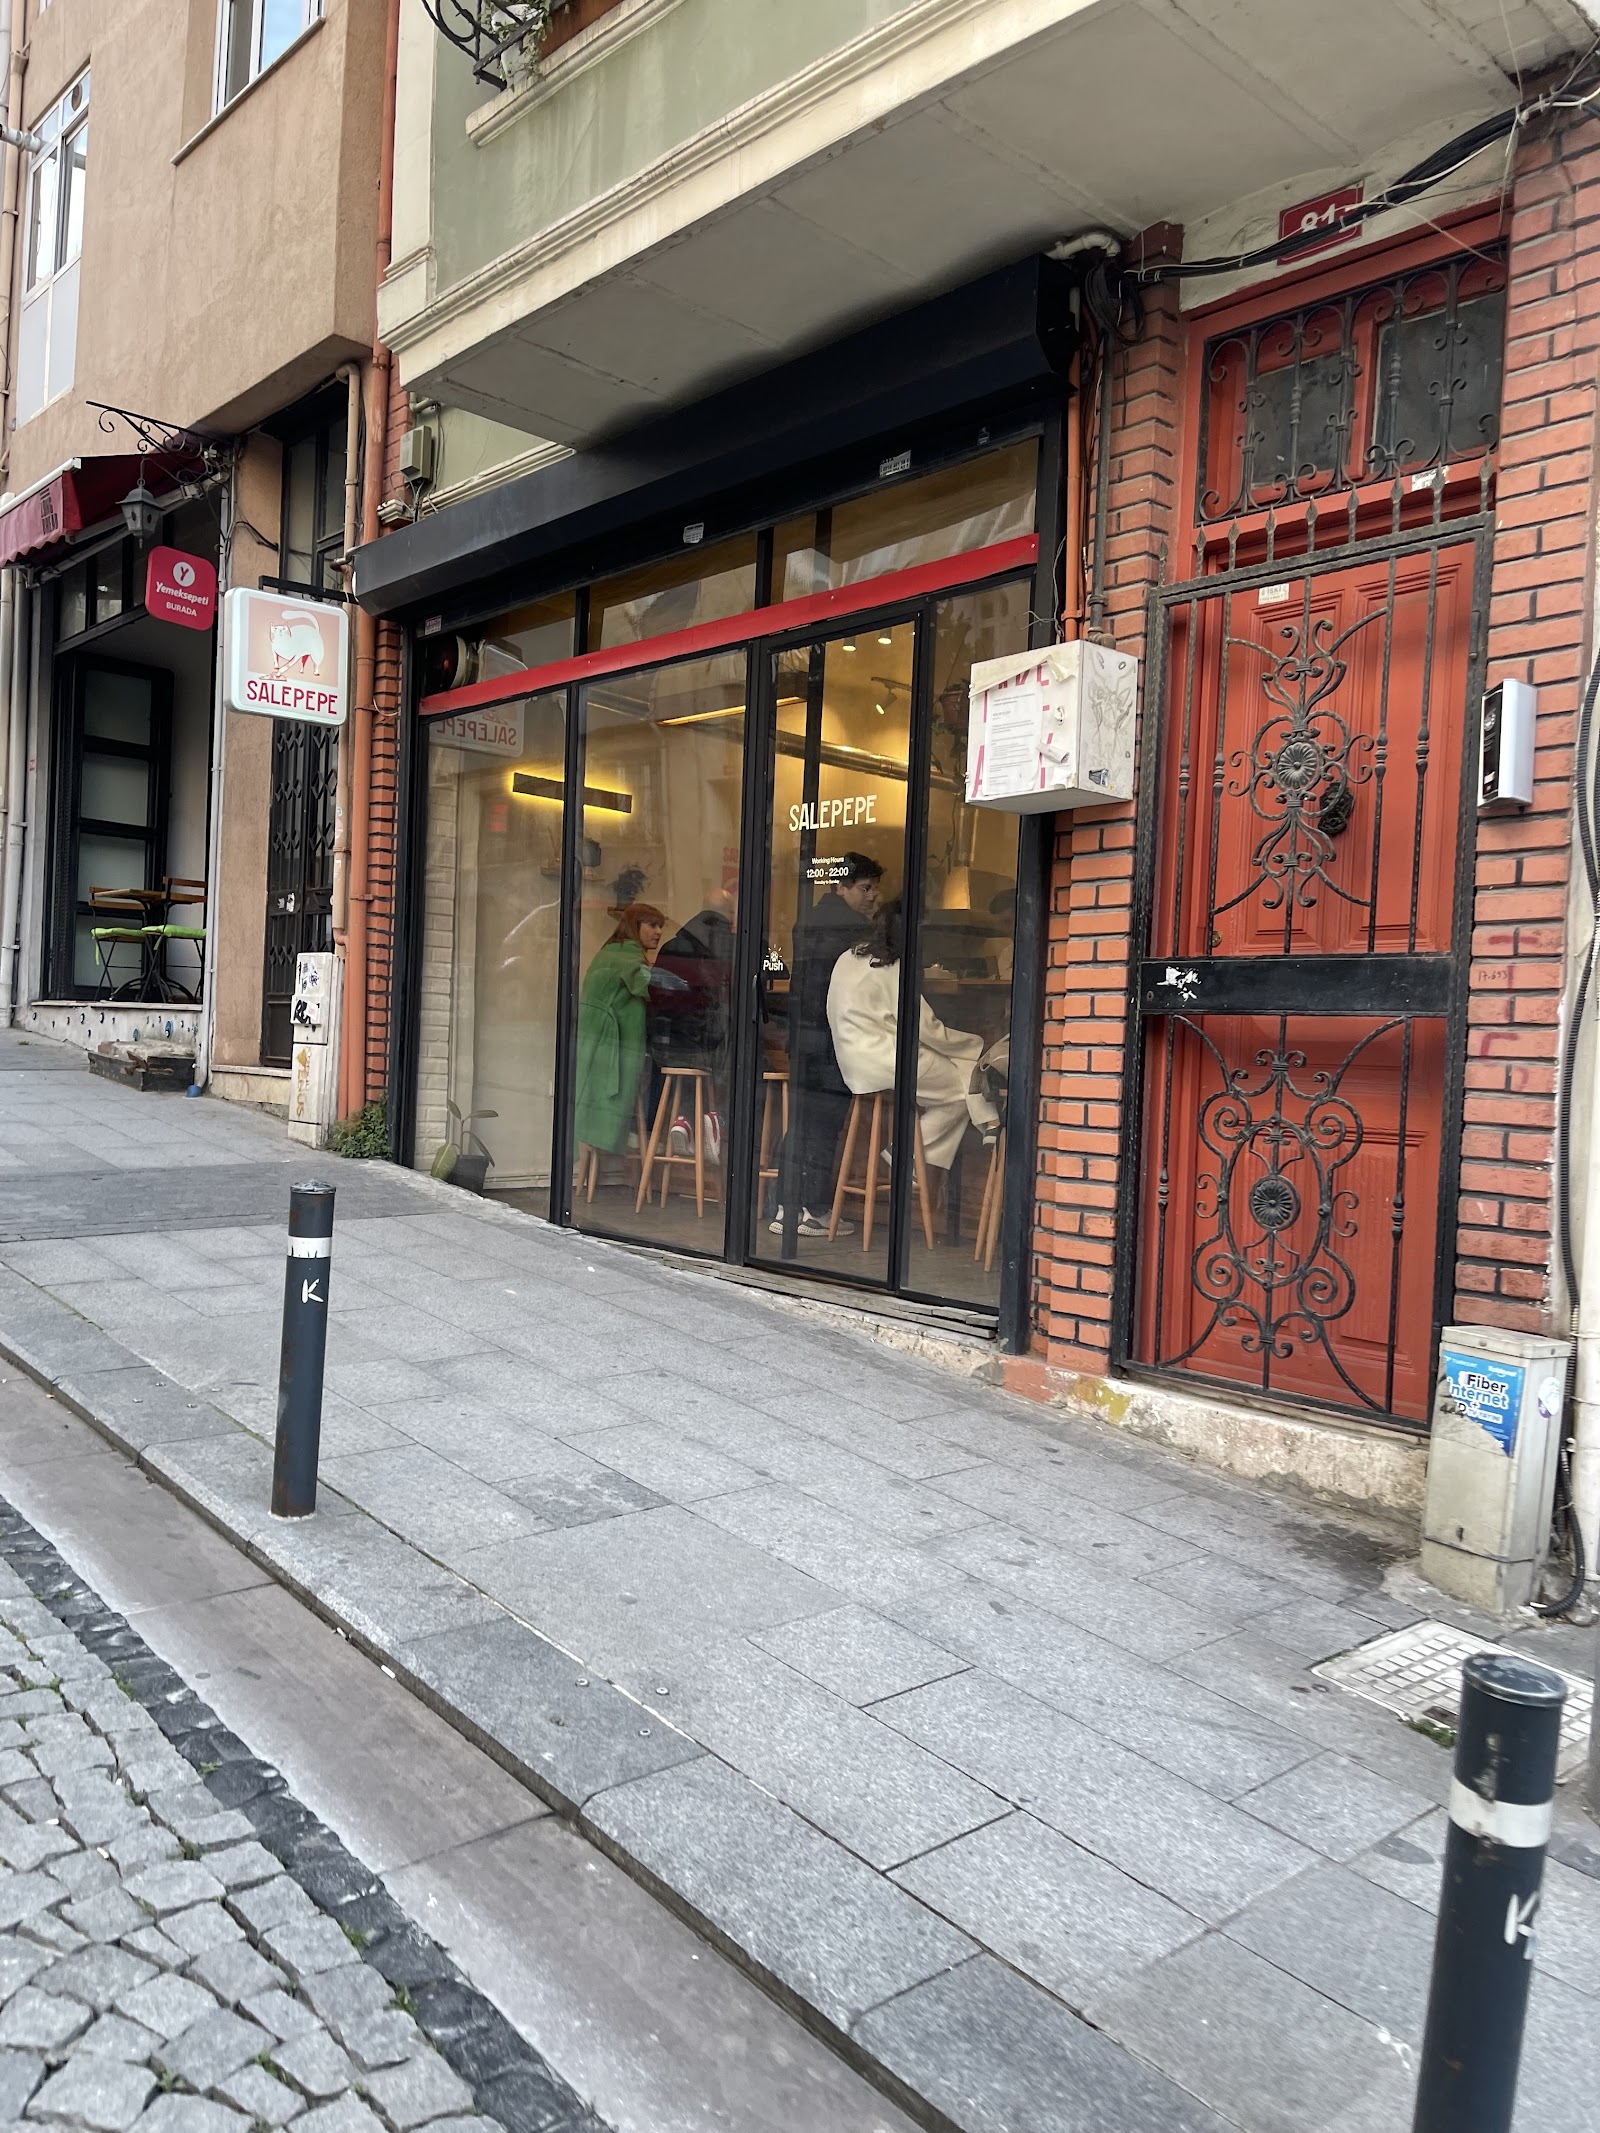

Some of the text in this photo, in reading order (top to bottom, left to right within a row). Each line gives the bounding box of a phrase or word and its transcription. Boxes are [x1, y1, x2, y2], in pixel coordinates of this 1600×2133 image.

[156, 581, 209, 606] Yemeksepeti
[166, 602, 197, 617] BURADA
[247, 680, 338, 715] SALEPEPE
[789, 795, 877, 832] SALEPEPE
[811, 857, 830, 865] Working
[806, 868, 824, 878] 12:00
[828, 867, 849, 877] 22:00
[763, 960, 784, 971] Push
[1467, 1374, 1506, 1393] Fiber
